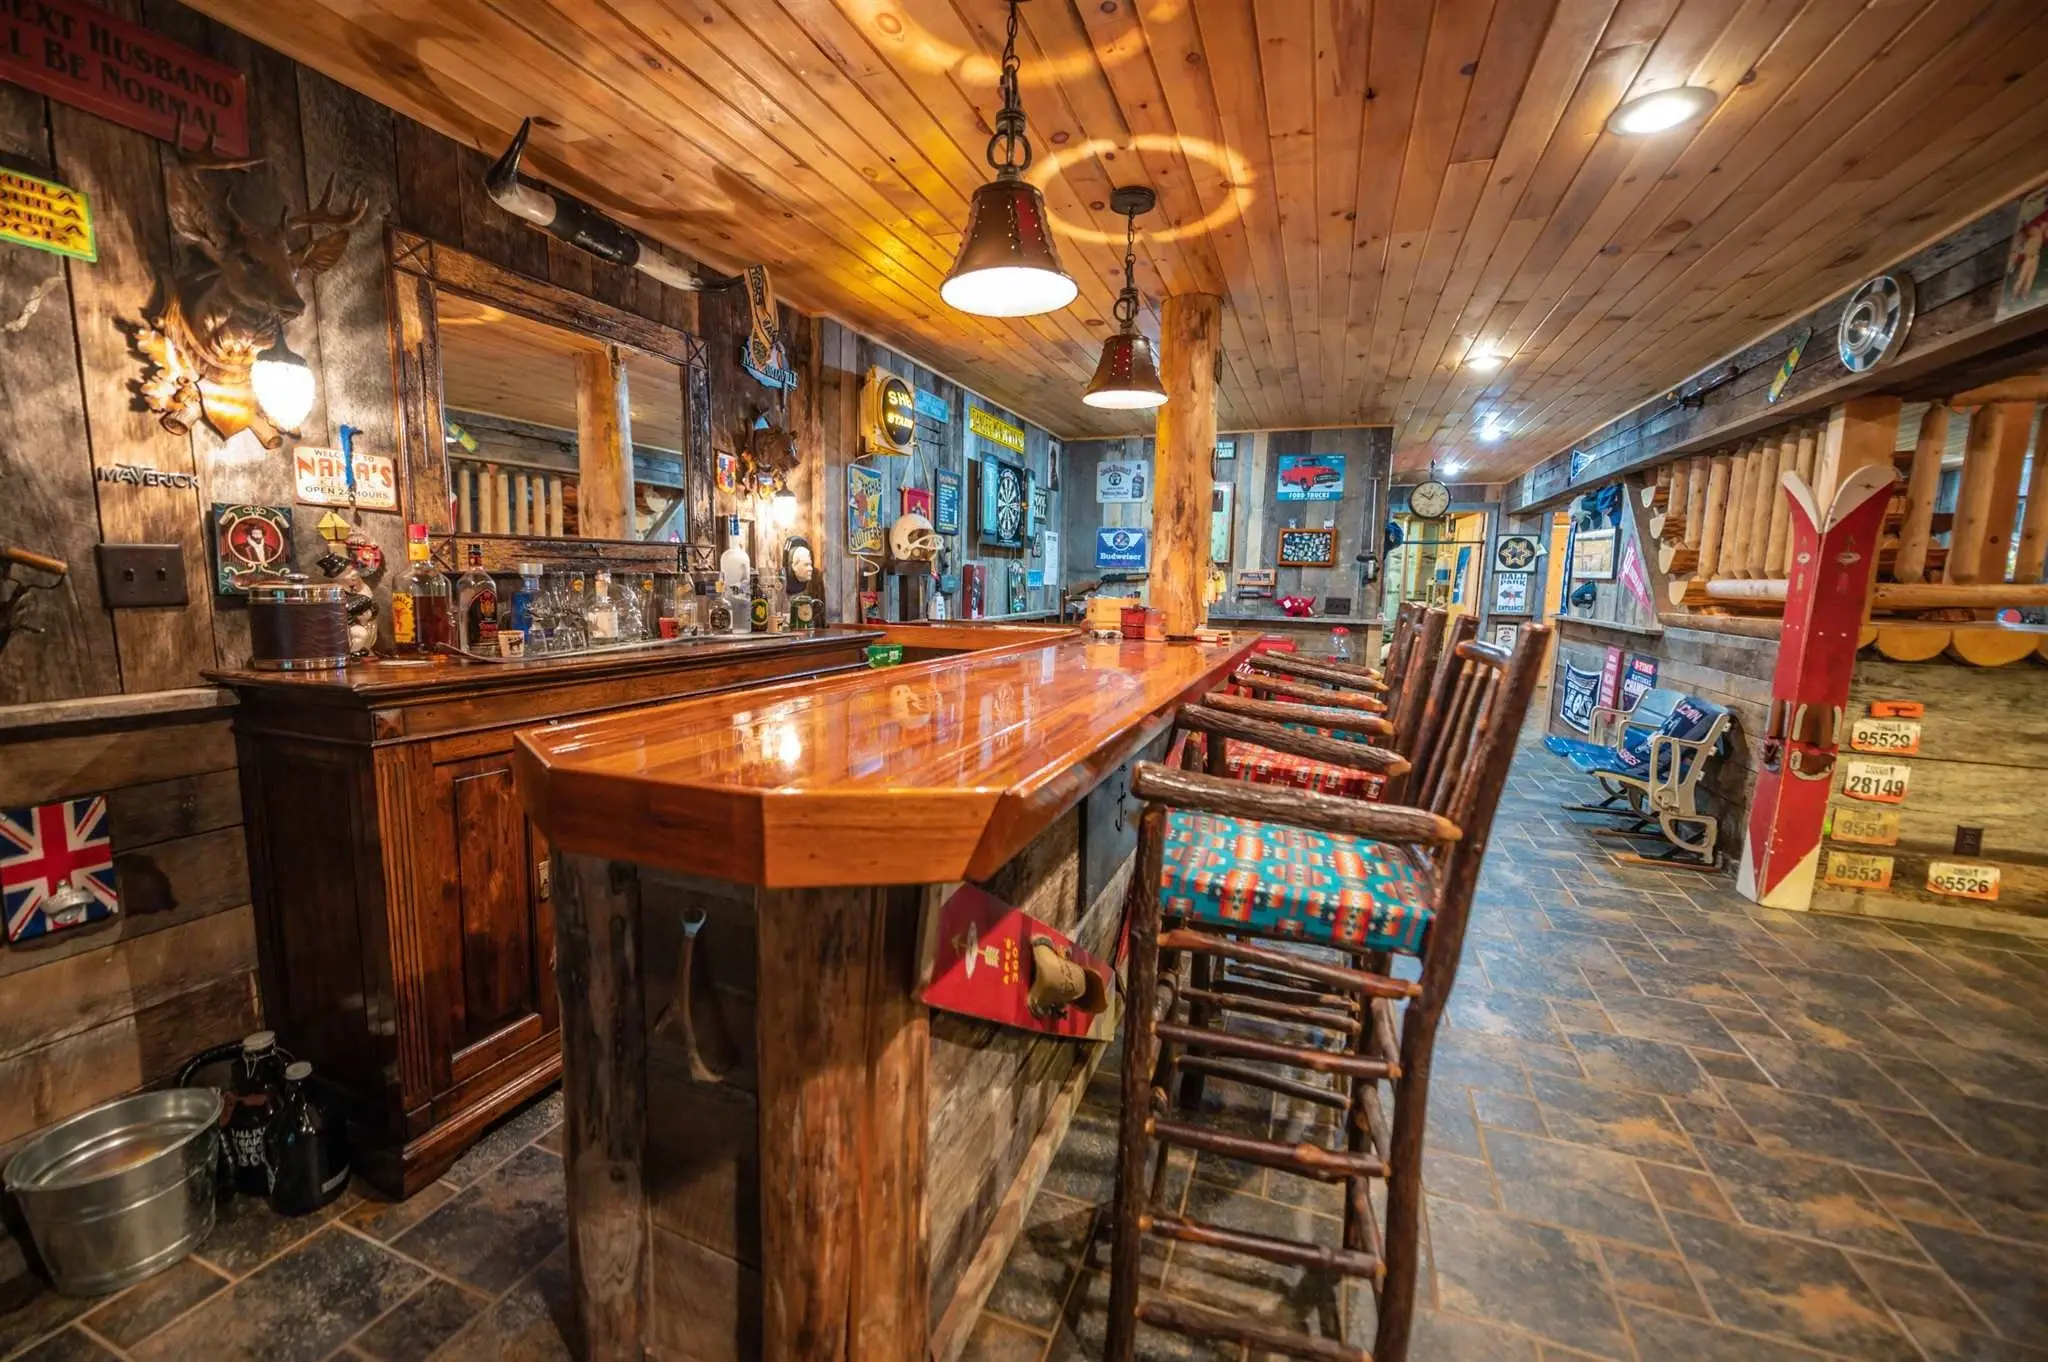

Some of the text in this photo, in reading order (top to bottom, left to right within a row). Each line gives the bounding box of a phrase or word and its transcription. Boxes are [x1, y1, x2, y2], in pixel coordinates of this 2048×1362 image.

[88, 20, 233, 107] HUSBAND
[44, 37, 90, 82] BE
[101, 61, 226, 137] NORMAL
[96, 463, 200, 489] MAVERICK
[305, 485, 335, 496] OPEN
[1289, 491, 1306, 499] FORD
[1307, 491, 1330, 500] TRUCKS
[1100, 551, 1142, 562] Budweiser
[1500, 572, 1526, 580] BALL
[1857, 731, 1911, 749] 95529
[1850, 775, 1905, 797] 28149
[1835, 863, 1882, 882] 9553
[1934, 875, 1989, 894] 95526
